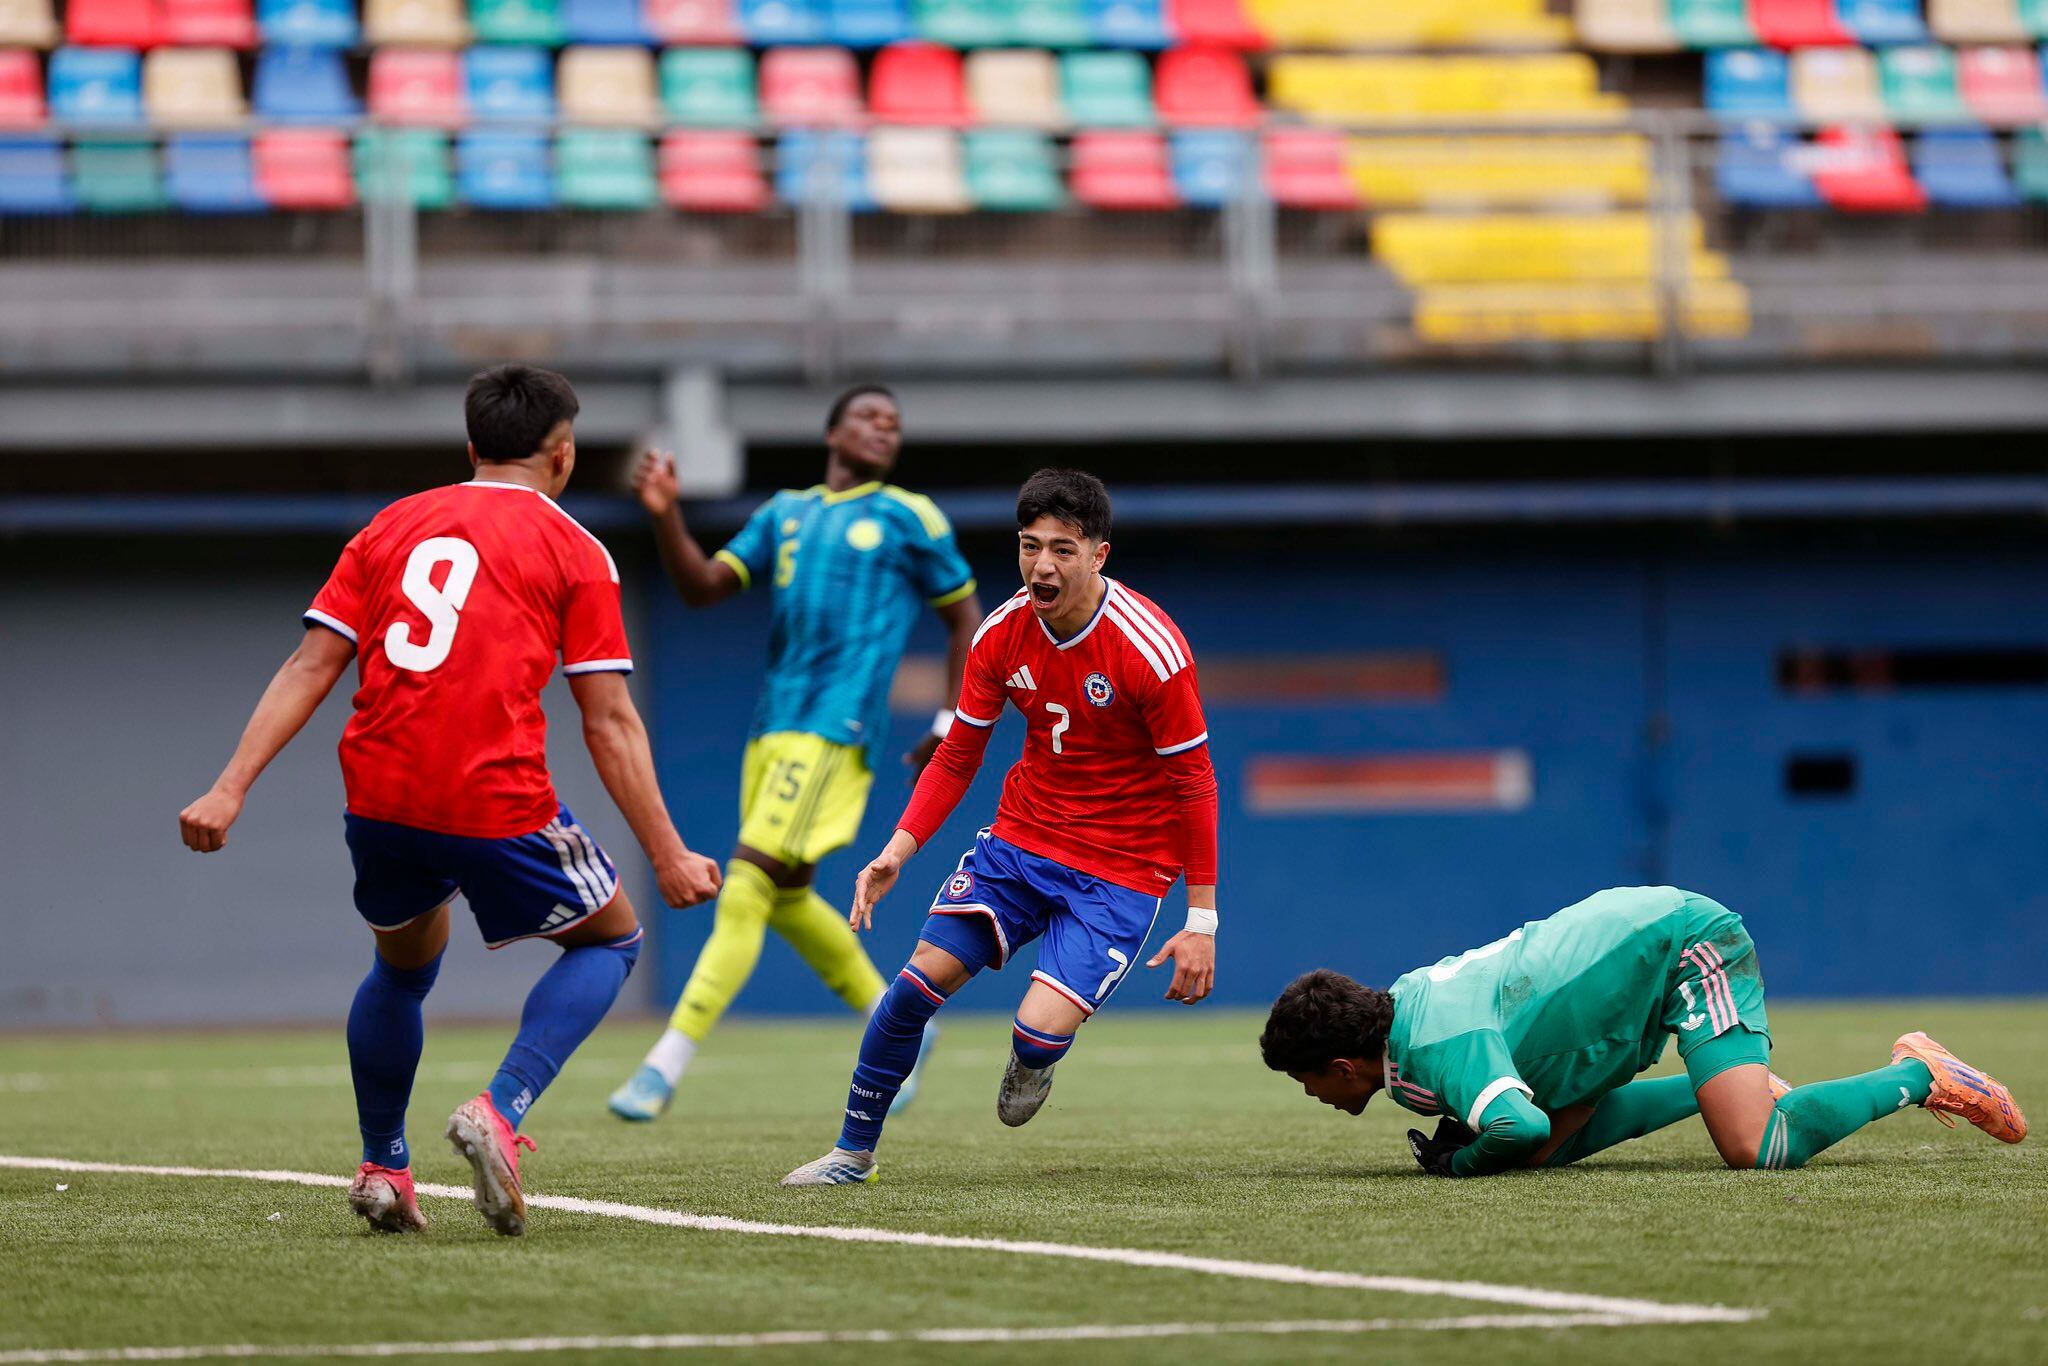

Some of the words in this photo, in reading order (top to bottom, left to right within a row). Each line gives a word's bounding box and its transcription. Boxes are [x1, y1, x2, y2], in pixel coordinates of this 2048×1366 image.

[384, 537, 479, 673] 9
[1045, 702, 1070, 754] 7
[1095, 947, 1128, 1000] 7
[851, 1083, 882, 1100] CHILE
